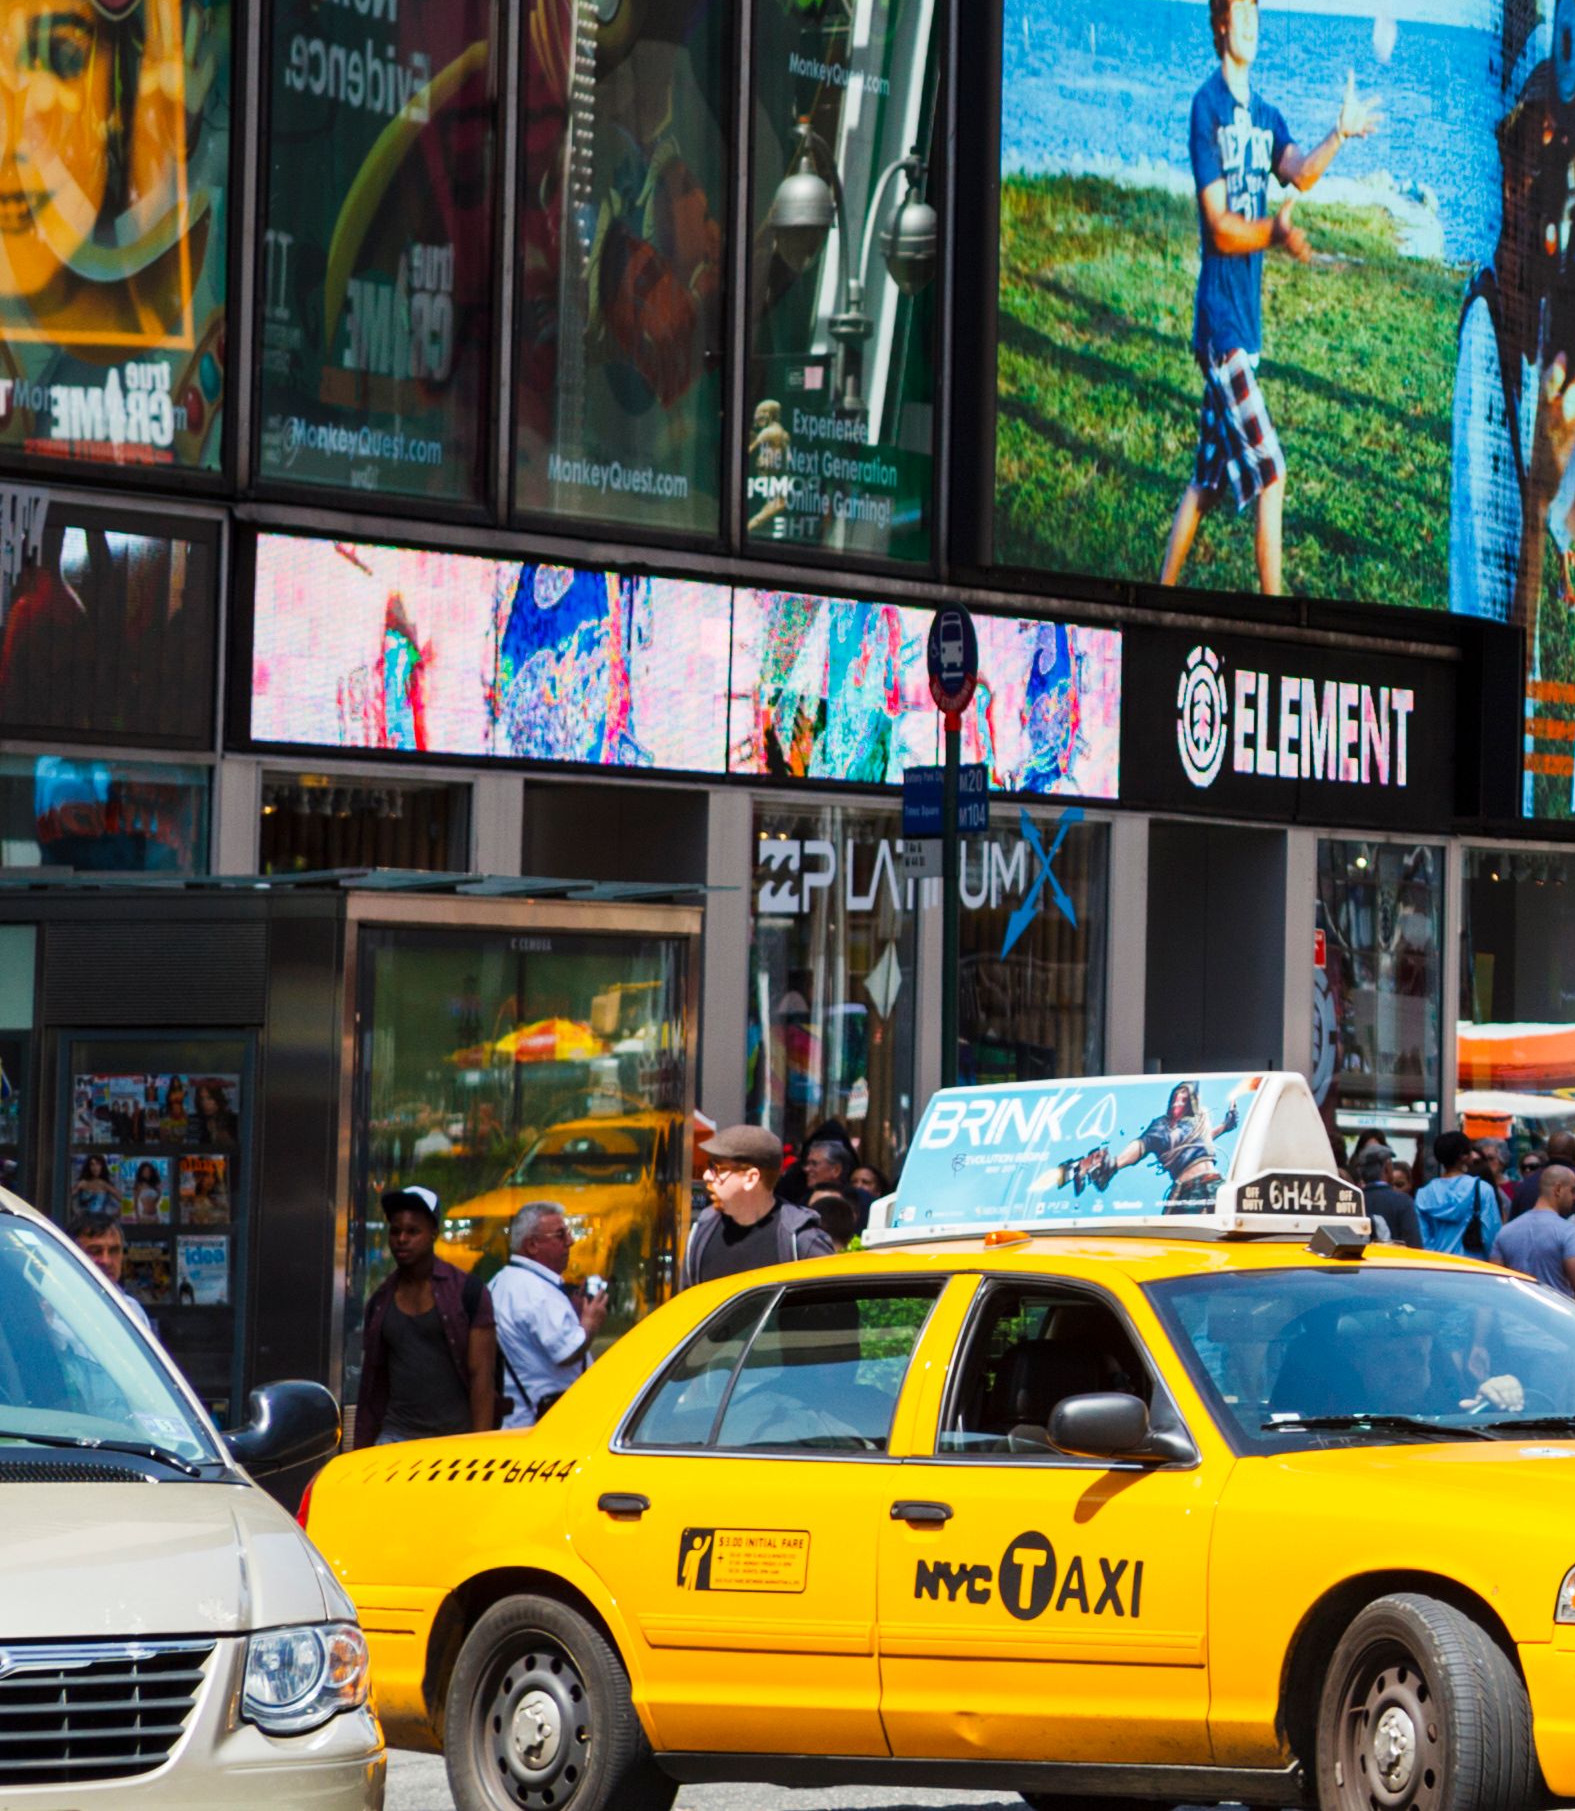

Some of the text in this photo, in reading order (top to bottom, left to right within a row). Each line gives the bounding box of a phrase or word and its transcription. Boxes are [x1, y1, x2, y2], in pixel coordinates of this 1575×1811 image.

[547, 451, 689, 499] MonkeyQuest.com
[785, 444, 821, 476] Next
[821, 456, 898, 488] Generation
[831, 493, 892, 526] Gaming!
[1233, 668, 1415, 788] ELEMENT
[959, 768, 984, 794] M20
[958, 802, 987, 828] M104
[919, 1093, 1083, 1151] BRINK
[1242, 1199, 1264, 1213] DUTY
[1244, 1186, 1261, 1199] OFF
[1268, 1180, 1328, 1213] 6H44
[1338, 1189, 1356, 1201] OFF
[1335, 1201, 1358, 1215] DUTY
[503, 1459, 578, 1484] 6H44
[913, 1535, 1145, 1620] NYC TAXI
